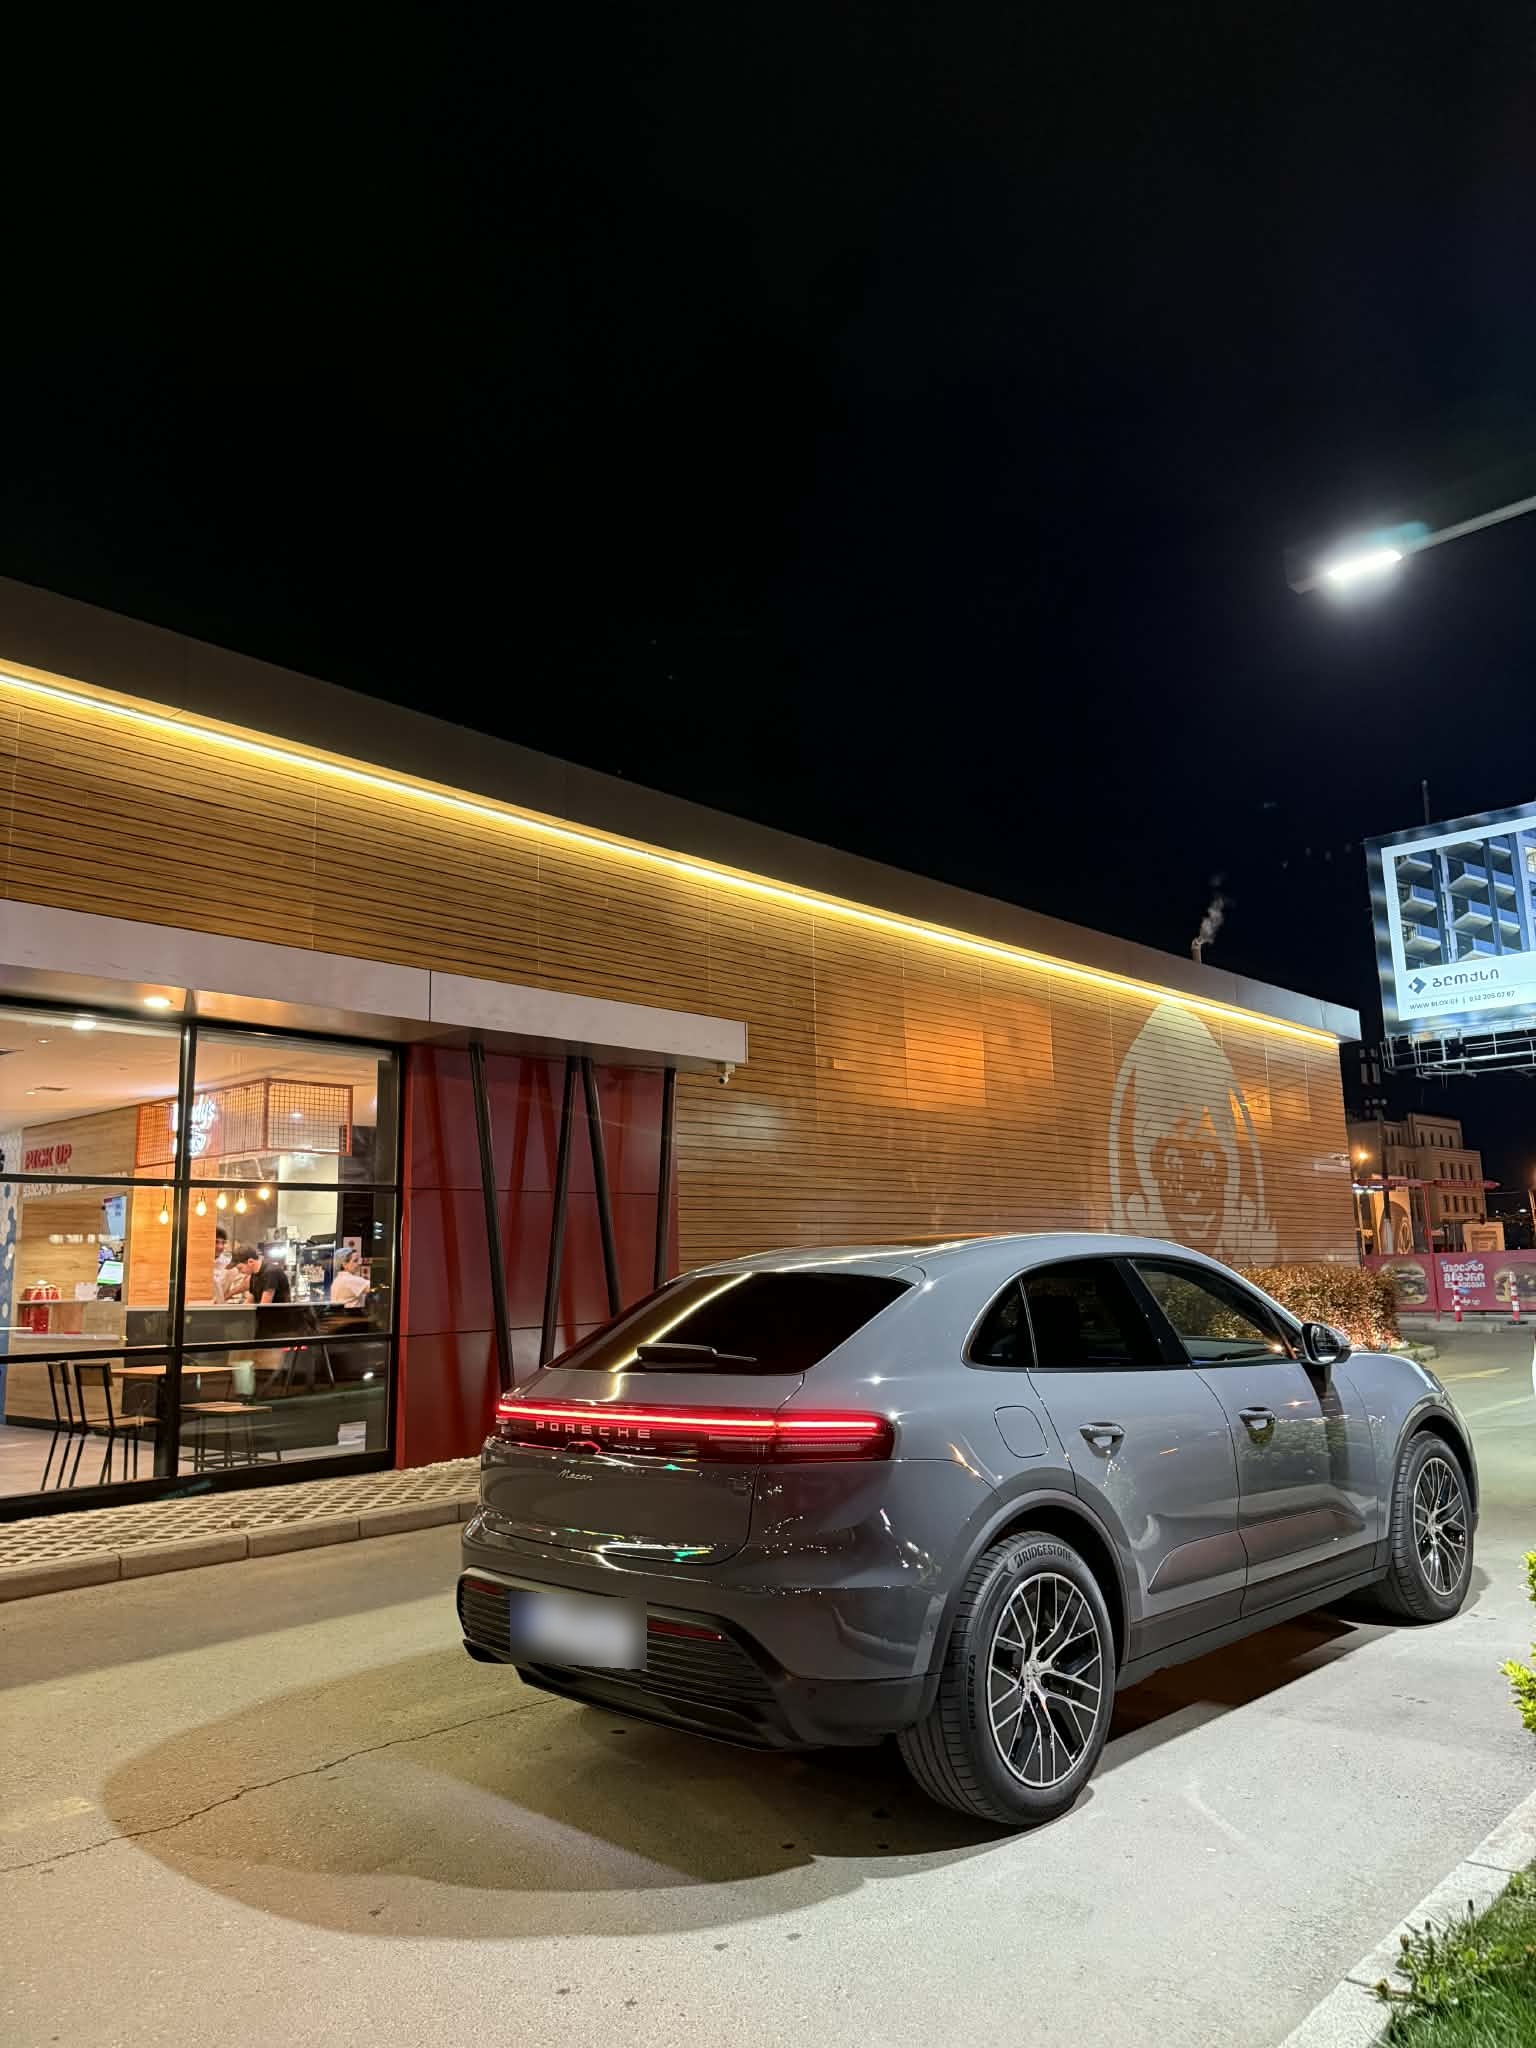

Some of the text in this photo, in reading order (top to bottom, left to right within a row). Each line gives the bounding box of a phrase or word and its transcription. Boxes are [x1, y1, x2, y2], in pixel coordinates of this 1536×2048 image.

[24, 1147, 54, 1170] PICK
[55, 1144, 72, 1165] UP
[535, 1421, 651, 1439] PORSCHE
[559, 1470, 593, 1481] Macan
[1014, 1544, 1073, 1569] BRIDGESTONE
